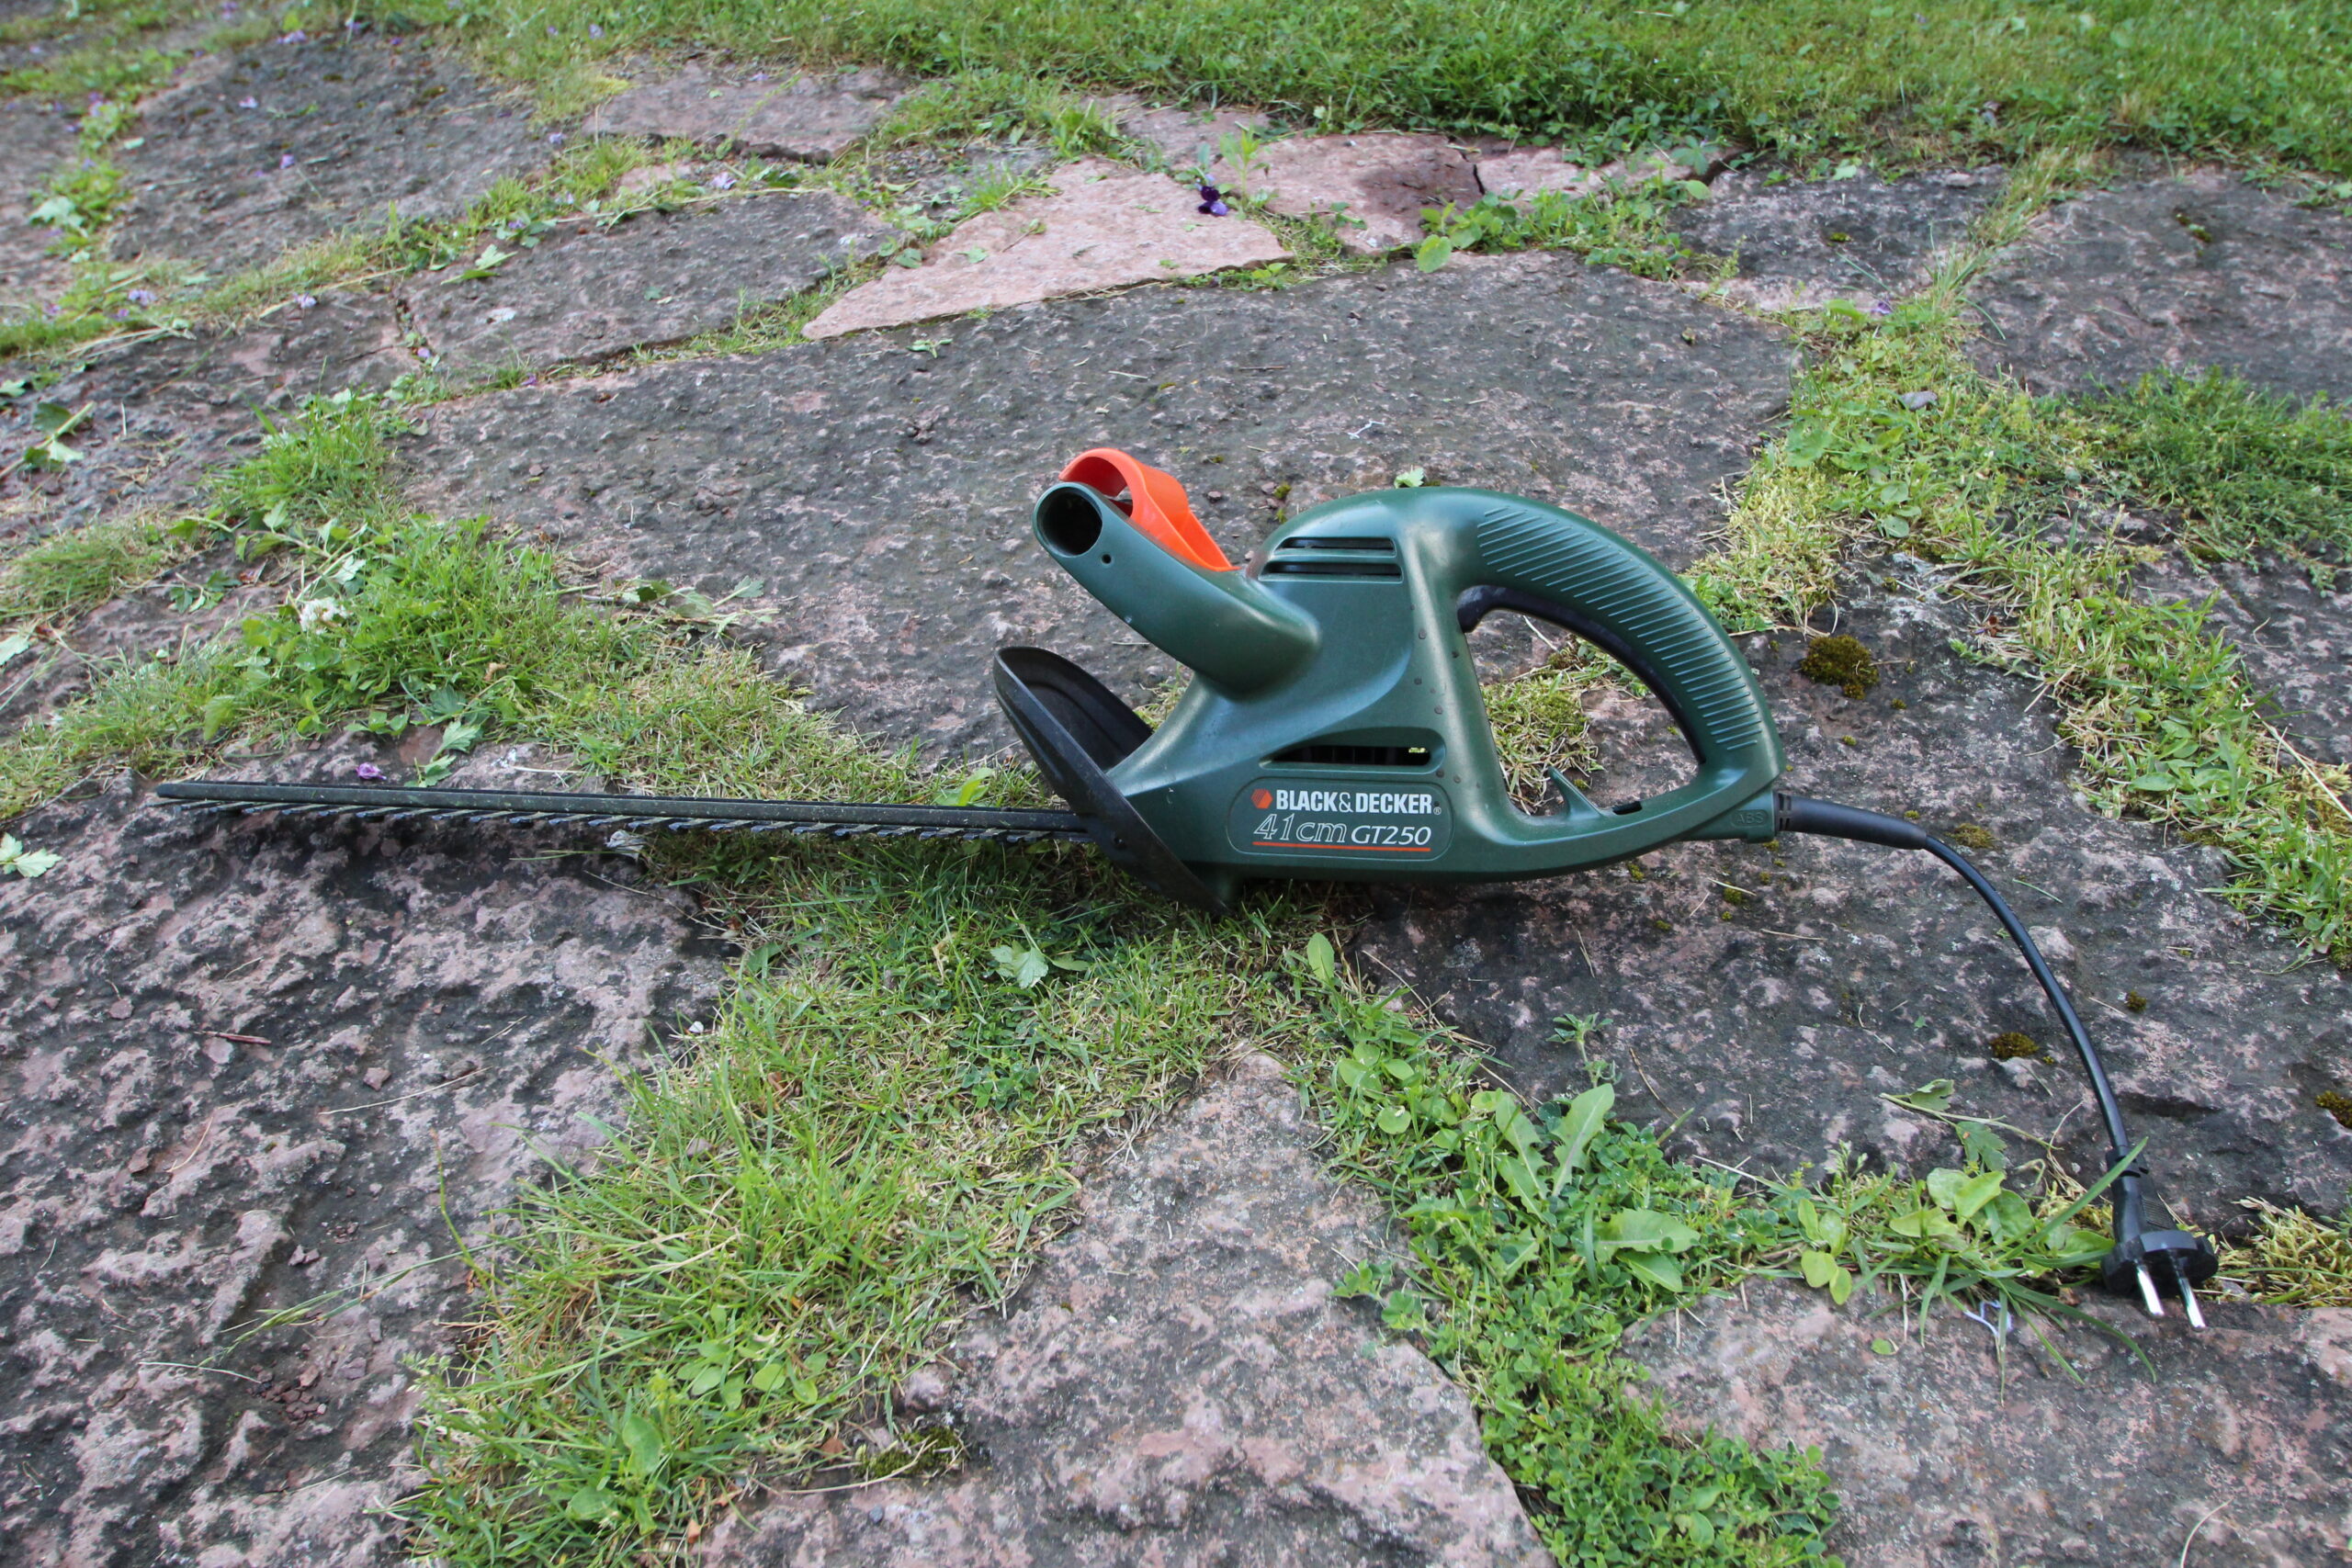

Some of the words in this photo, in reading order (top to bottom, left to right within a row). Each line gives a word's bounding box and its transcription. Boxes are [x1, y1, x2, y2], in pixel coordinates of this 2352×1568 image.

[1735, 811, 1764, 824] ABS
[1253, 813, 1347, 842] 41cm
[1351, 825, 1431, 845] GT250
